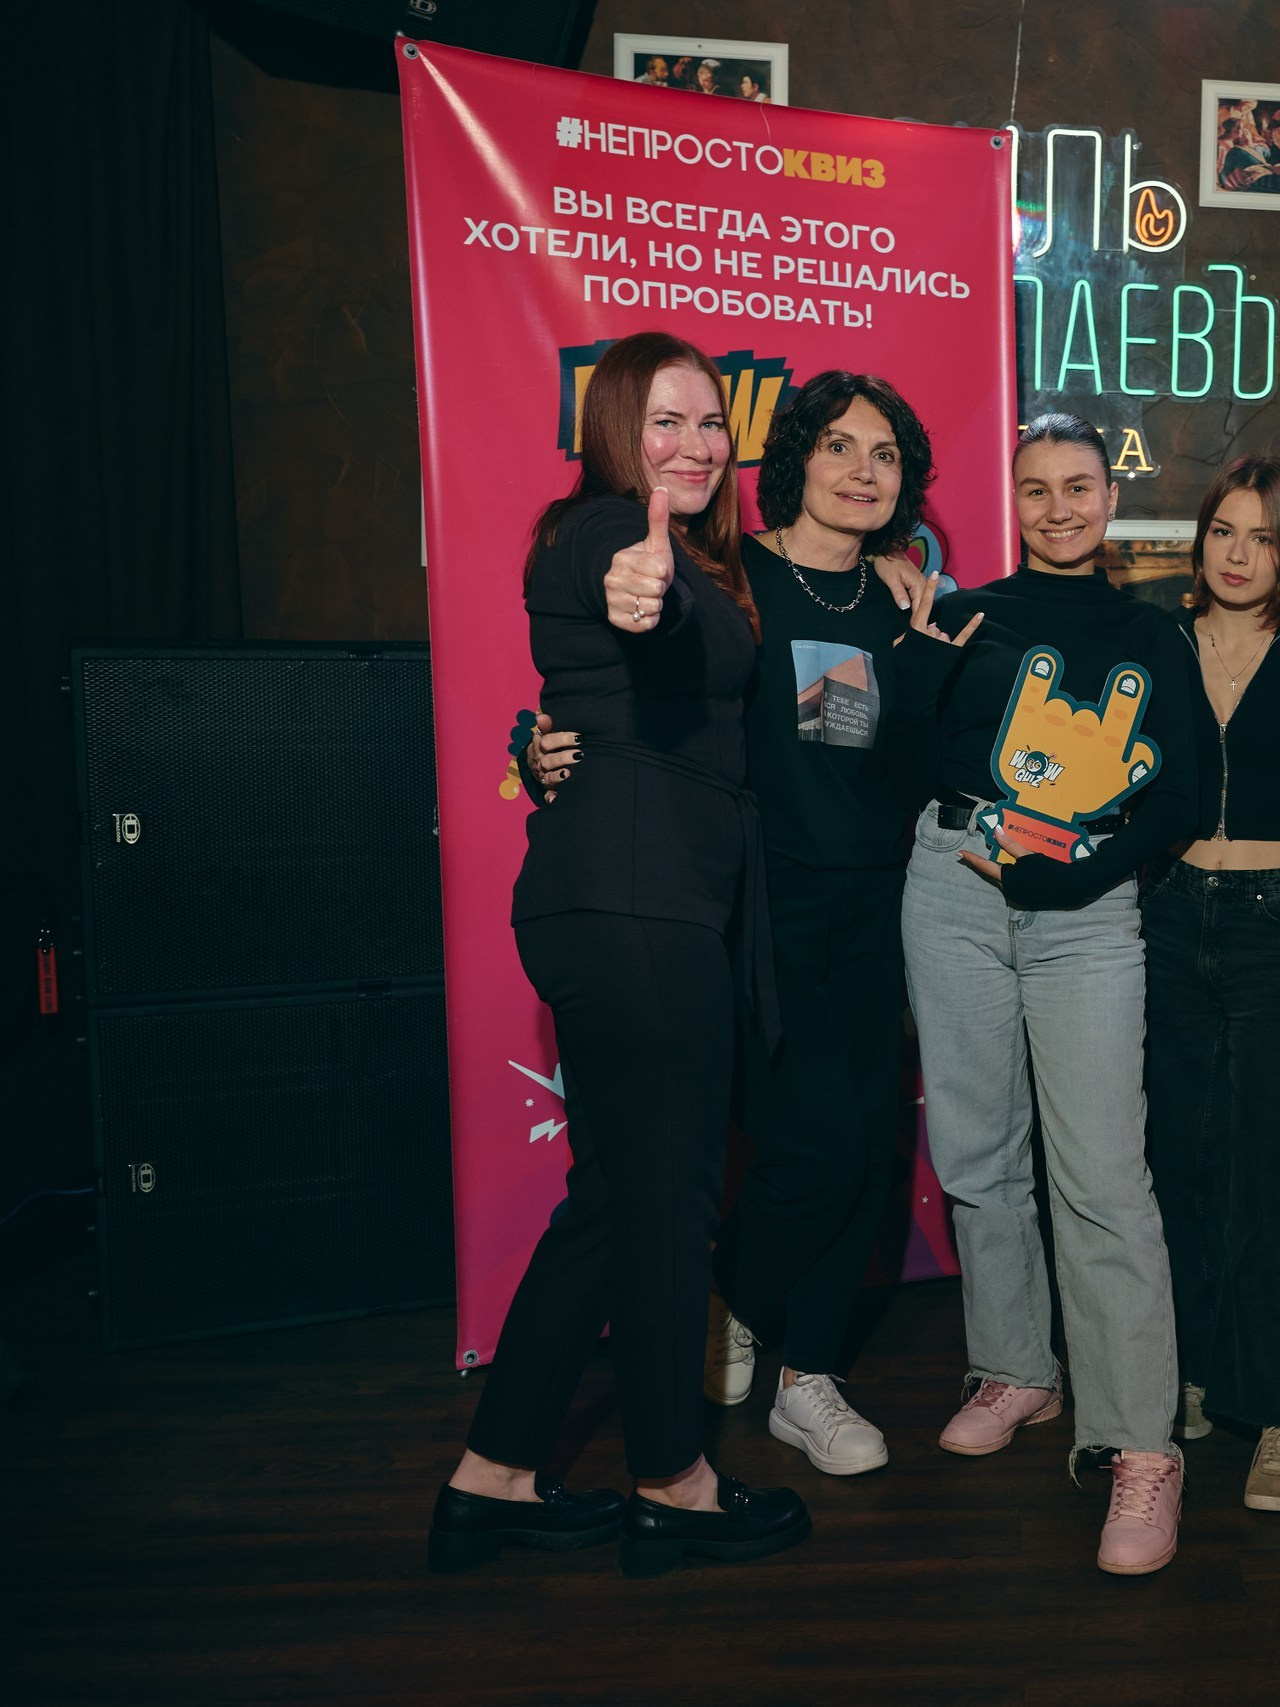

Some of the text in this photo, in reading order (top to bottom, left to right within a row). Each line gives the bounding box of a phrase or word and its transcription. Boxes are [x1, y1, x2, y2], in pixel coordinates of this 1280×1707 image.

[556, 117, 885, 188] #НЕПРОСТОКВИЗ
[554, 187, 896, 254] ВЫ ВСЕГДА ЭТОГО
[1007, 126, 1187, 258] ЛЬ
[463, 217, 971, 299] ХОТЕЛИ, НО НЕ РЕШАЛИСЬ
[584, 274, 873, 329] ПОПРОБОВАТЬ!
[825, 720, 868, 737] УЖДАЕШЬСЯ
[1015, 767, 1045, 788] QUIZ
